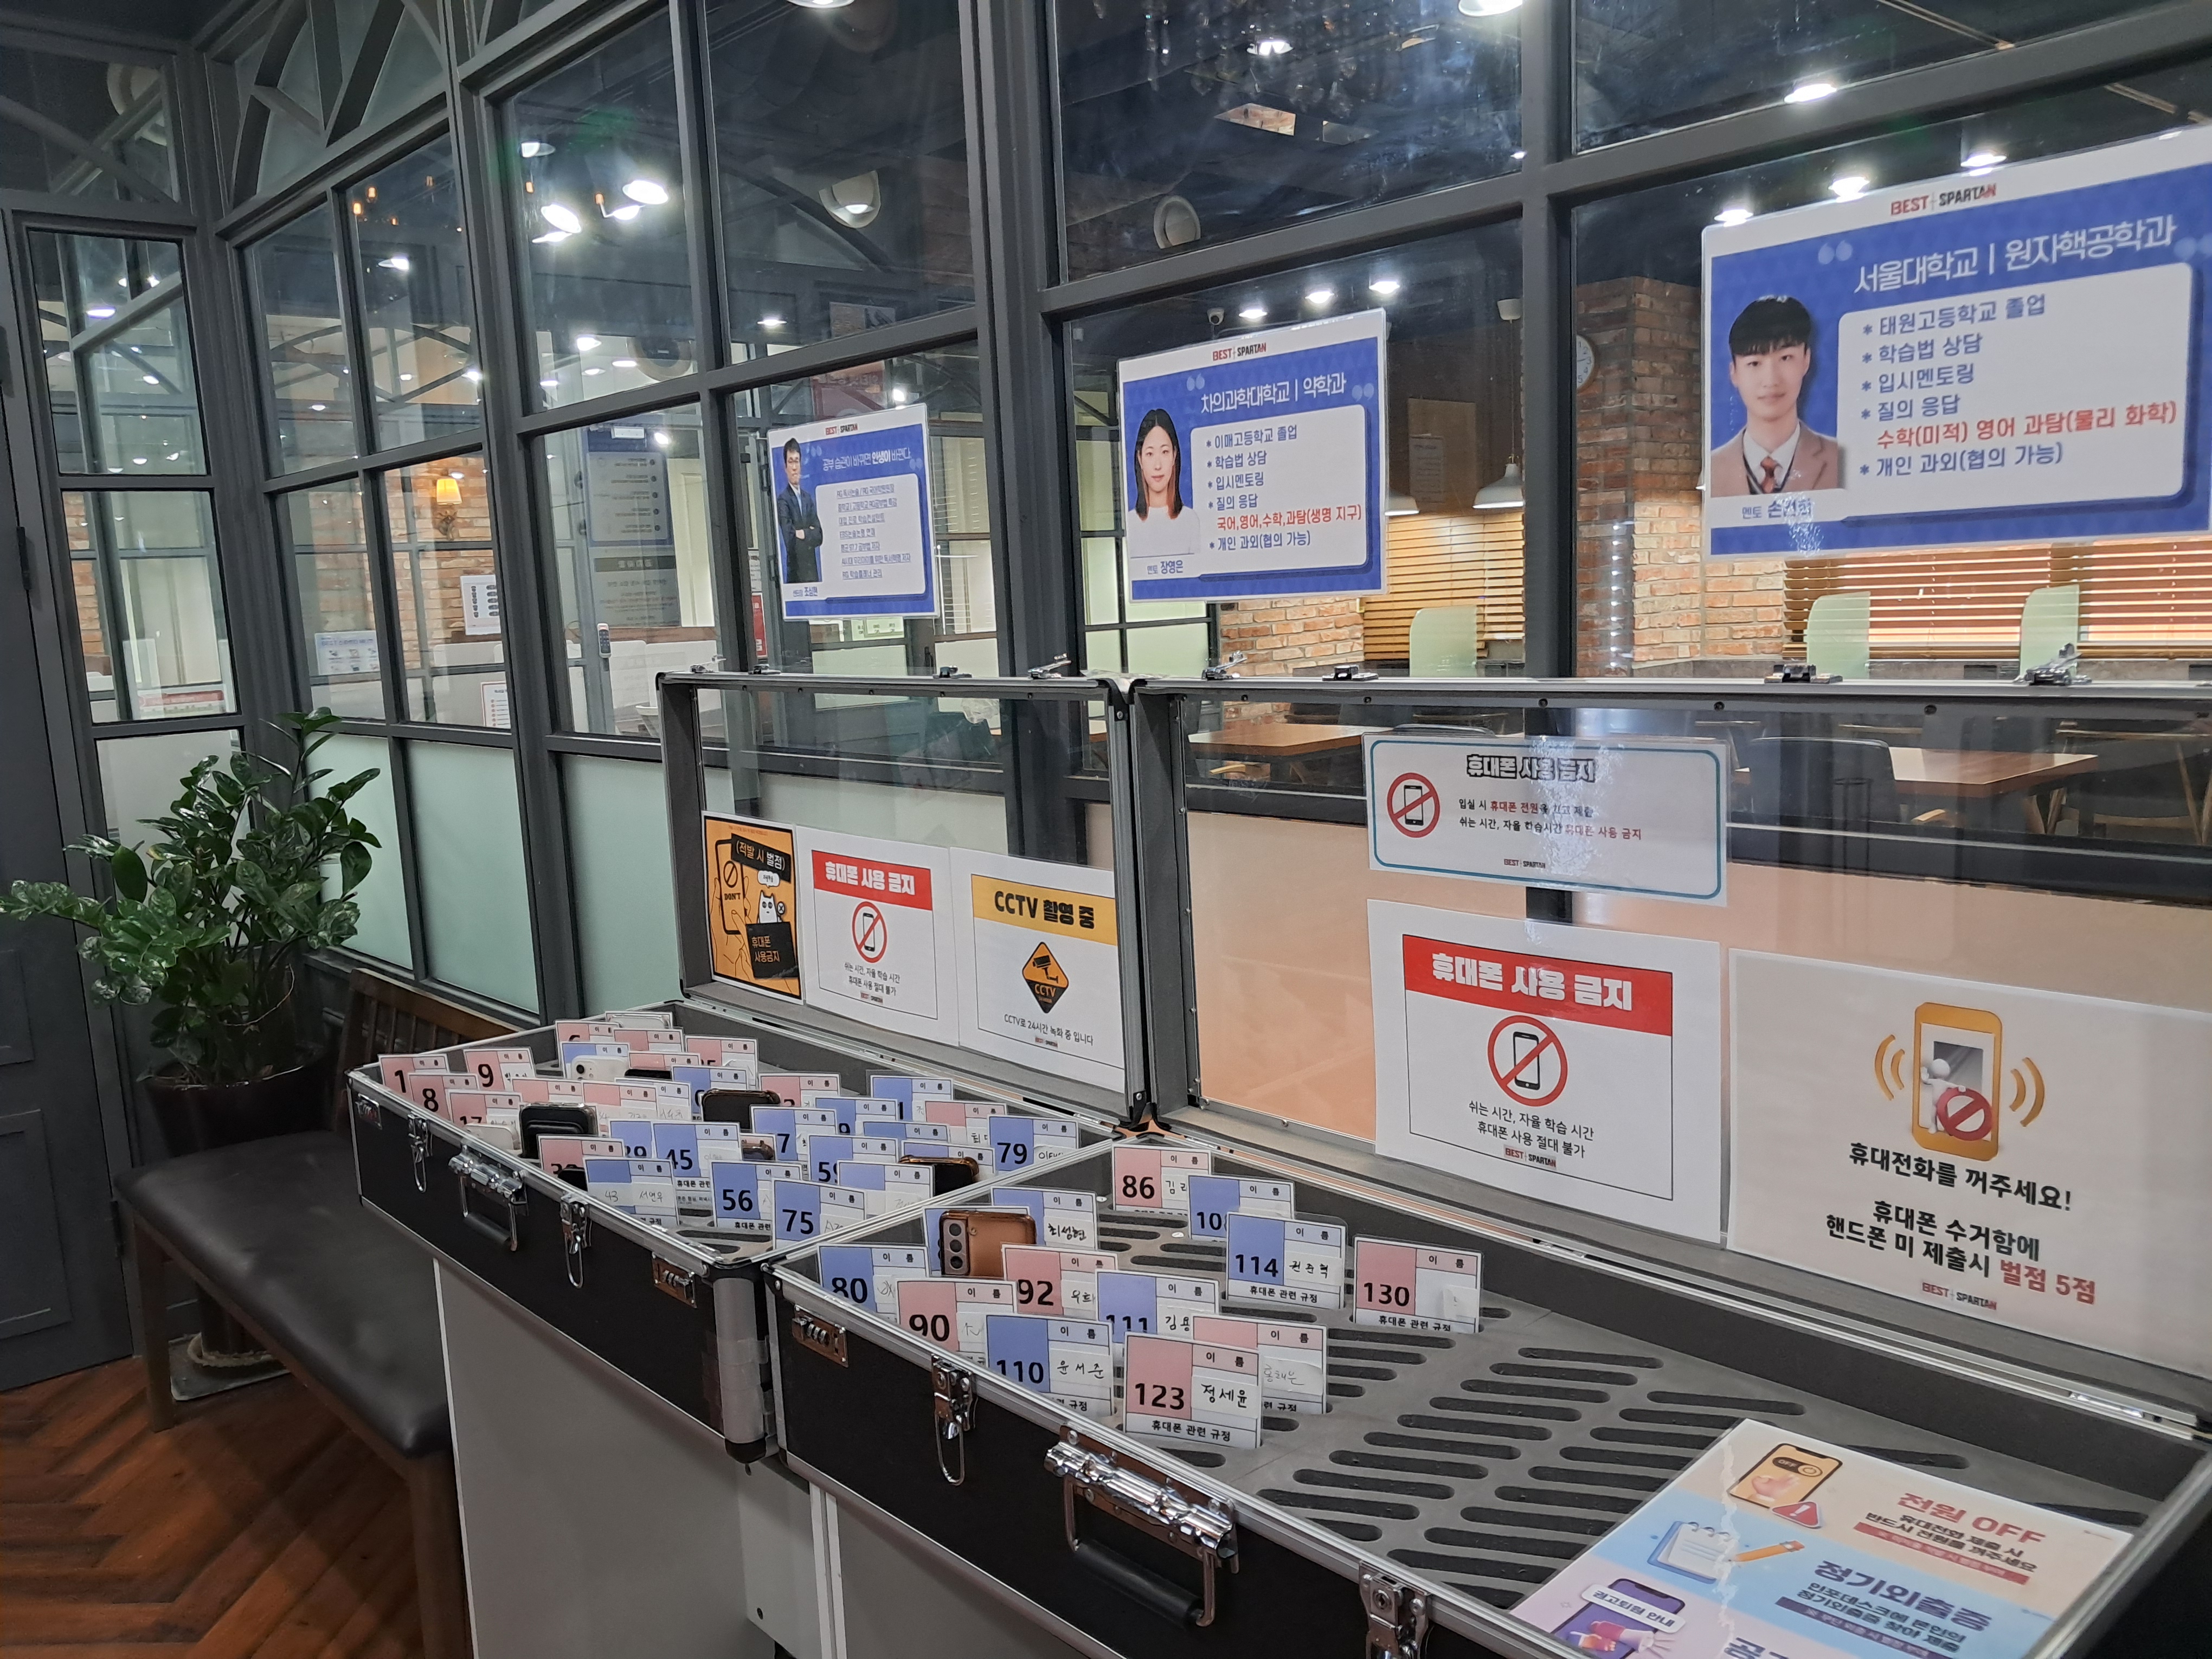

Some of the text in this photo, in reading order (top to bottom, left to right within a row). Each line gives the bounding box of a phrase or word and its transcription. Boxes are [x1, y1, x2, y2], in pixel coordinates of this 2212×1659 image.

[1891, 183, 1997, 216] BEST SPARTAN
[1854, 216, 2177, 294] 서울대학교 원자핵공학과
[1880, 295, 2046, 336] 태원고등학교 졸업
[1212, 343, 1266, 361] BEST SPARTAN
[1879, 333, 1983, 363] 학습법 상담
[1879, 364, 1975, 393] 입시멘토링
[1201, 372, 1347, 414] 차의과학대학교 약학과
[1877, 394, 1962, 421] 질의 응답
[826, 423, 858, 435] BEST SPARTAN
[1214, 425, 1297, 449] 이매고등학교 졸업
[1877, 402, 2177, 449] 수학(미적) 영어 과탐(물리 화학)
[822, 458, 834, 471] 공부
[834, 455, 852, 470] 습관이
[872, 450, 890, 465] 인생이
[1215, 451, 1267, 469] 학습법 상담
[1876, 441, 2062, 477] 개인 과외(협의 가능)
[1216, 472, 1264, 490] 입시멘토링
[1217, 494, 1258, 510] 질의 응답
[1336, 505, 1361, 522] 지구)
[1742, 507, 1761, 519] 멘토
[1218, 531, 1310, 551] 개인 과외(협의 가능)
[1161, 561, 1184, 574] 장영은
[1467, 754, 1596, 783] 휴대폰 사용 금지
[1459, 799, 1475, 810] 입실
[1479, 800, 1486, 811] 시
[1490, 801, 1517, 813] 휴대폰
[1521, 802, 1548, 814] 전원을
[1459, 817, 1476, 828] 쉬는
[1480, 818, 1499, 830] 시간,
[1503, 820, 1521, 832] 자율
[1598, 827, 1617, 839] 사용
[1622, 828, 1642, 840] 금지
[736, 840, 785, 871] (적발 시 벌점)
[825, 862, 915, 895] 휴대폰 사용 금지
[995, 891, 1095, 929] CCTV 촬영 중
[751, 936, 771, 948] 휴대폰
[755, 951, 780, 963] 사용금지
[844, 962, 900, 983] 쉬는 시간, 자율 학습 시간
[1432, 953, 1632, 1011] 휴대폰 사용 금지
[849, 976, 896, 995] 휴대폰 사용 절대 불가
[1034, 983, 1057, 998] CCTV
[1005, 1014, 1026, 1028] CCTV로
[1027, 1021, 1048, 1034] 24시간
[1050, 1027, 1063, 1038] 녹화
[1065, 1030, 1071, 1040] 중
[1073, 1032, 1094, 1046] 입니다
[395, 1070, 406, 1093] 1
[478, 1064, 494, 1087] 9
[422, 1089, 439, 1112] 8
[1469, 1101, 1594, 1141] 쉬는 시간, 자율 학습 시간
[1477, 1121, 1585, 1159] 휴대폰 사용 절대 불가
[666, 1149, 693, 1170] 45
[997, 1142, 1027, 1164] 79
[1505, 1148, 1556, 1167] BEST SPARTAN
[818, 1162, 837, 1183] 5
[1850, 1142, 2071, 1211] 휴대전화를 꺼주세요!
[605, 1189, 618, 1202] 43
[1122, 1175, 1154, 1199] 86
[723, 1189, 753, 1211] 56
[782, 1210, 814, 1234] 75
[1197, 1212, 1226, 1230] 10
[1874, 1200, 2040, 1261] 휴대폰 수거함에
[1236, 1255, 1278, 1277] 114
[1826, 1215, 2096, 1305] 핸드폰 미 제출시 벌점 5점
[831, 1278, 868, 1303] 80
[1017, 1279, 1054, 1306] 92
[1250, 1286, 1317, 1303] 휴대폰 관련 규정
[1363, 1282, 1410, 1307] 130
[1922, 1283, 1997, 1310] BEST SPARTAN
[909, 1315, 950, 1341] 90
[1106, 1314, 1148, 1333] 111
[1379, 1315, 1406, 1327] 휴대폰
[1410, 1318, 1429, 1330] 관련
[1206, 1352, 1215, 1362] 이
[997, 1360, 1044, 1384] 110
[1135, 1382, 1185, 1410] 123
[1278, 1403, 1297, 1412] 규정
[1152, 1420, 1231, 1442] 휴대폰 관련 규정
[1777, 1459, 1796, 1468] OFF
[1898, 1493, 2046, 1543] 전원 OFF
[1866, 1513, 1914, 1533] 반드시
[1969, 1546, 2037, 1572] 꺼주세요
[1900, 1514, 1965, 1540] 휴대전화
[2004, 1547, 2024, 1557] 시
[1796, 1589, 1880, 1624] 정기외출증
[1806, 1582, 1911, 1623] 인포데스크에
[1815, 1560, 1992, 1631] 정기외출증
[1646, 1611, 1676, 1628] 안내
